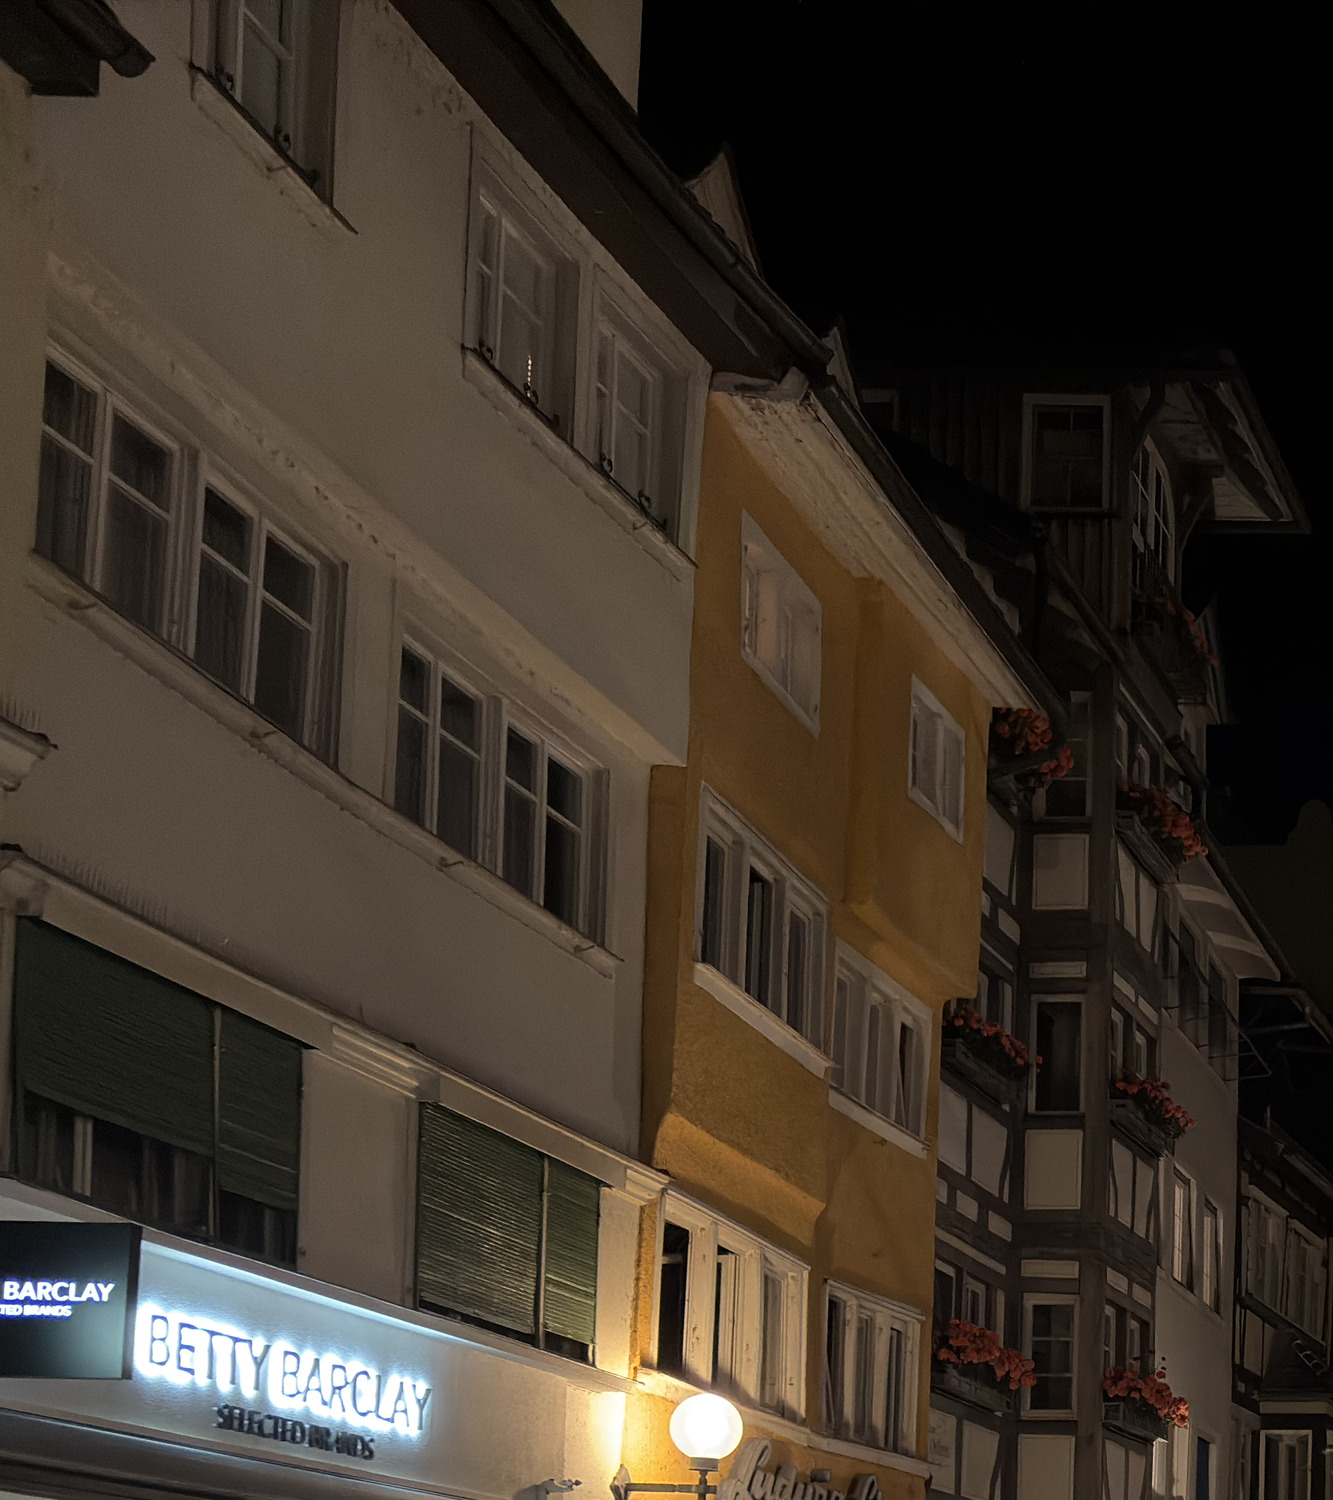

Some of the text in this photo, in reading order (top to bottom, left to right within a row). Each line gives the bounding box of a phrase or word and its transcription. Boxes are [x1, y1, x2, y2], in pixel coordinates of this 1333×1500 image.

[3, 1281, 116, 1302] BARCLAY
[23, 1305, 72, 1316] BRANDS
[149, 1314, 433, 1431] BETTY BARCLAY
[213, 1403, 305, 1445] SELECTED
